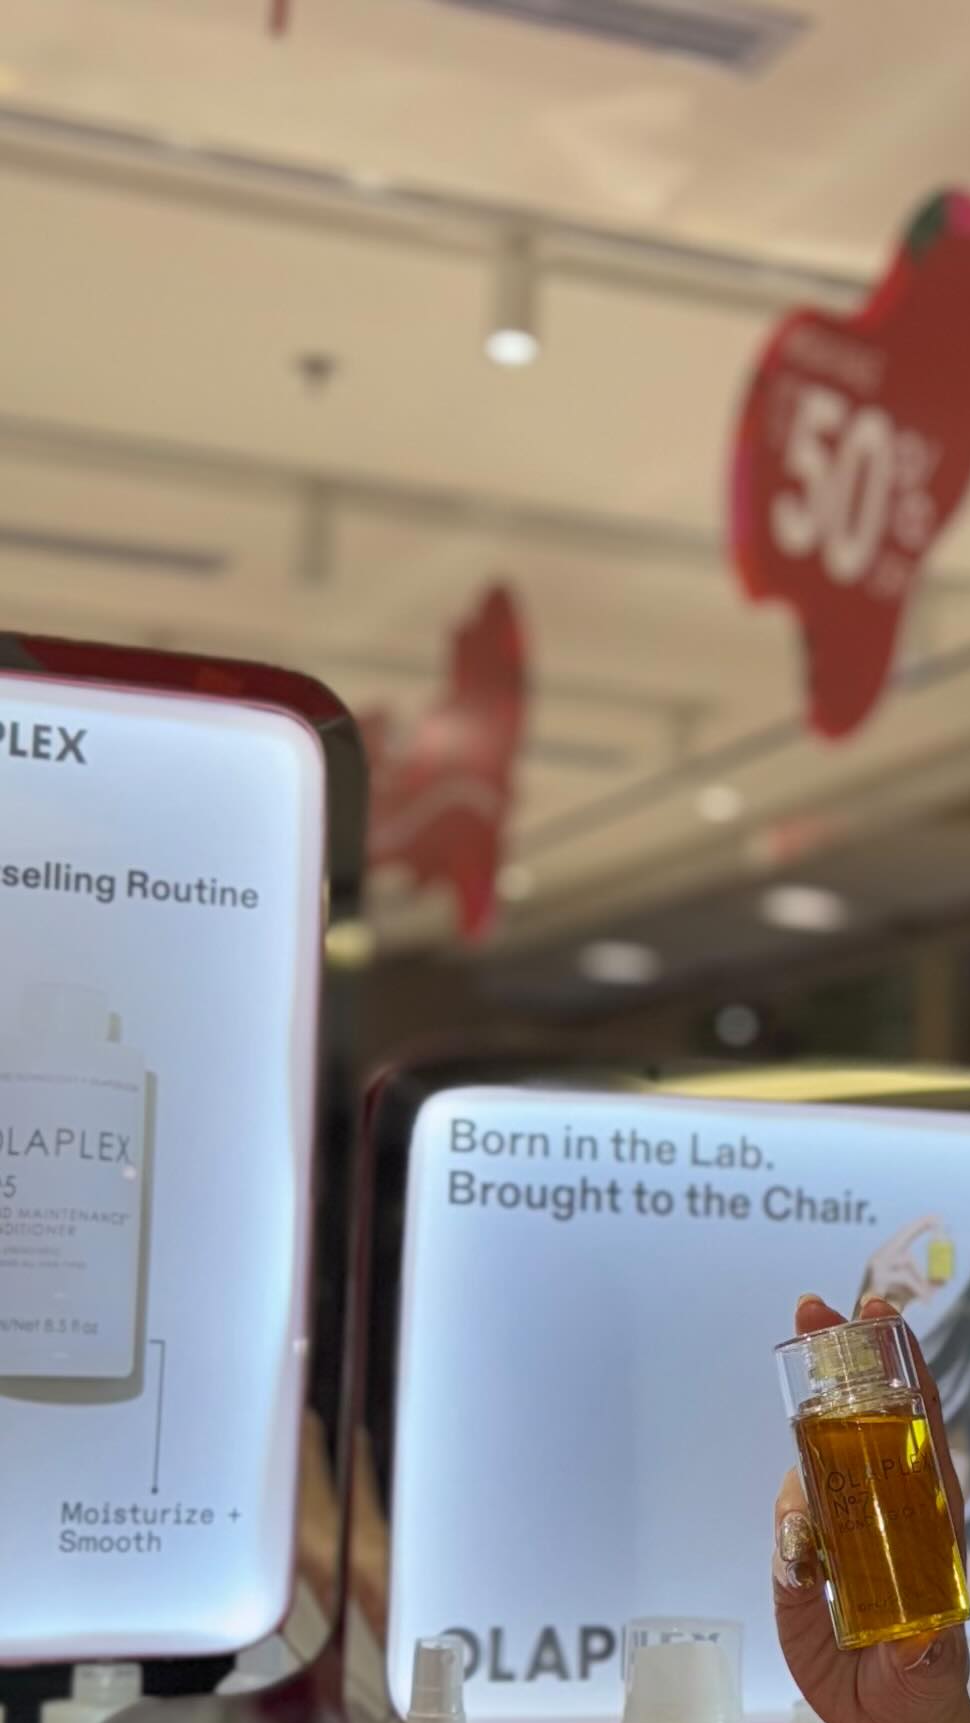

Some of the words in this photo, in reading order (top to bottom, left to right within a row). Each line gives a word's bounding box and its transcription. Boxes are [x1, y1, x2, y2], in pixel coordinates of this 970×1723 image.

[0, 721, 87, 765] LEX
[0, 861, 115, 904] selling
[127, 869, 259, 909] Routine
[0, 1127, 132, 1164] LAPLEX
[450, 1118, 550, 1158] Born
[564, 1125, 598, 1160] in
[610, 1129, 676, 1165] the
[690, 1133, 775, 1170] Lab.
[449, 1169, 621, 1221] Brought
[632, 1181, 674, 1217] to
[686, 1184, 751, 1220] the
[762, 1185, 877, 1226] Chair.
[60, 1501, 215, 1526] Moisturize
[59, 1529, 162, 1553] Smooth
